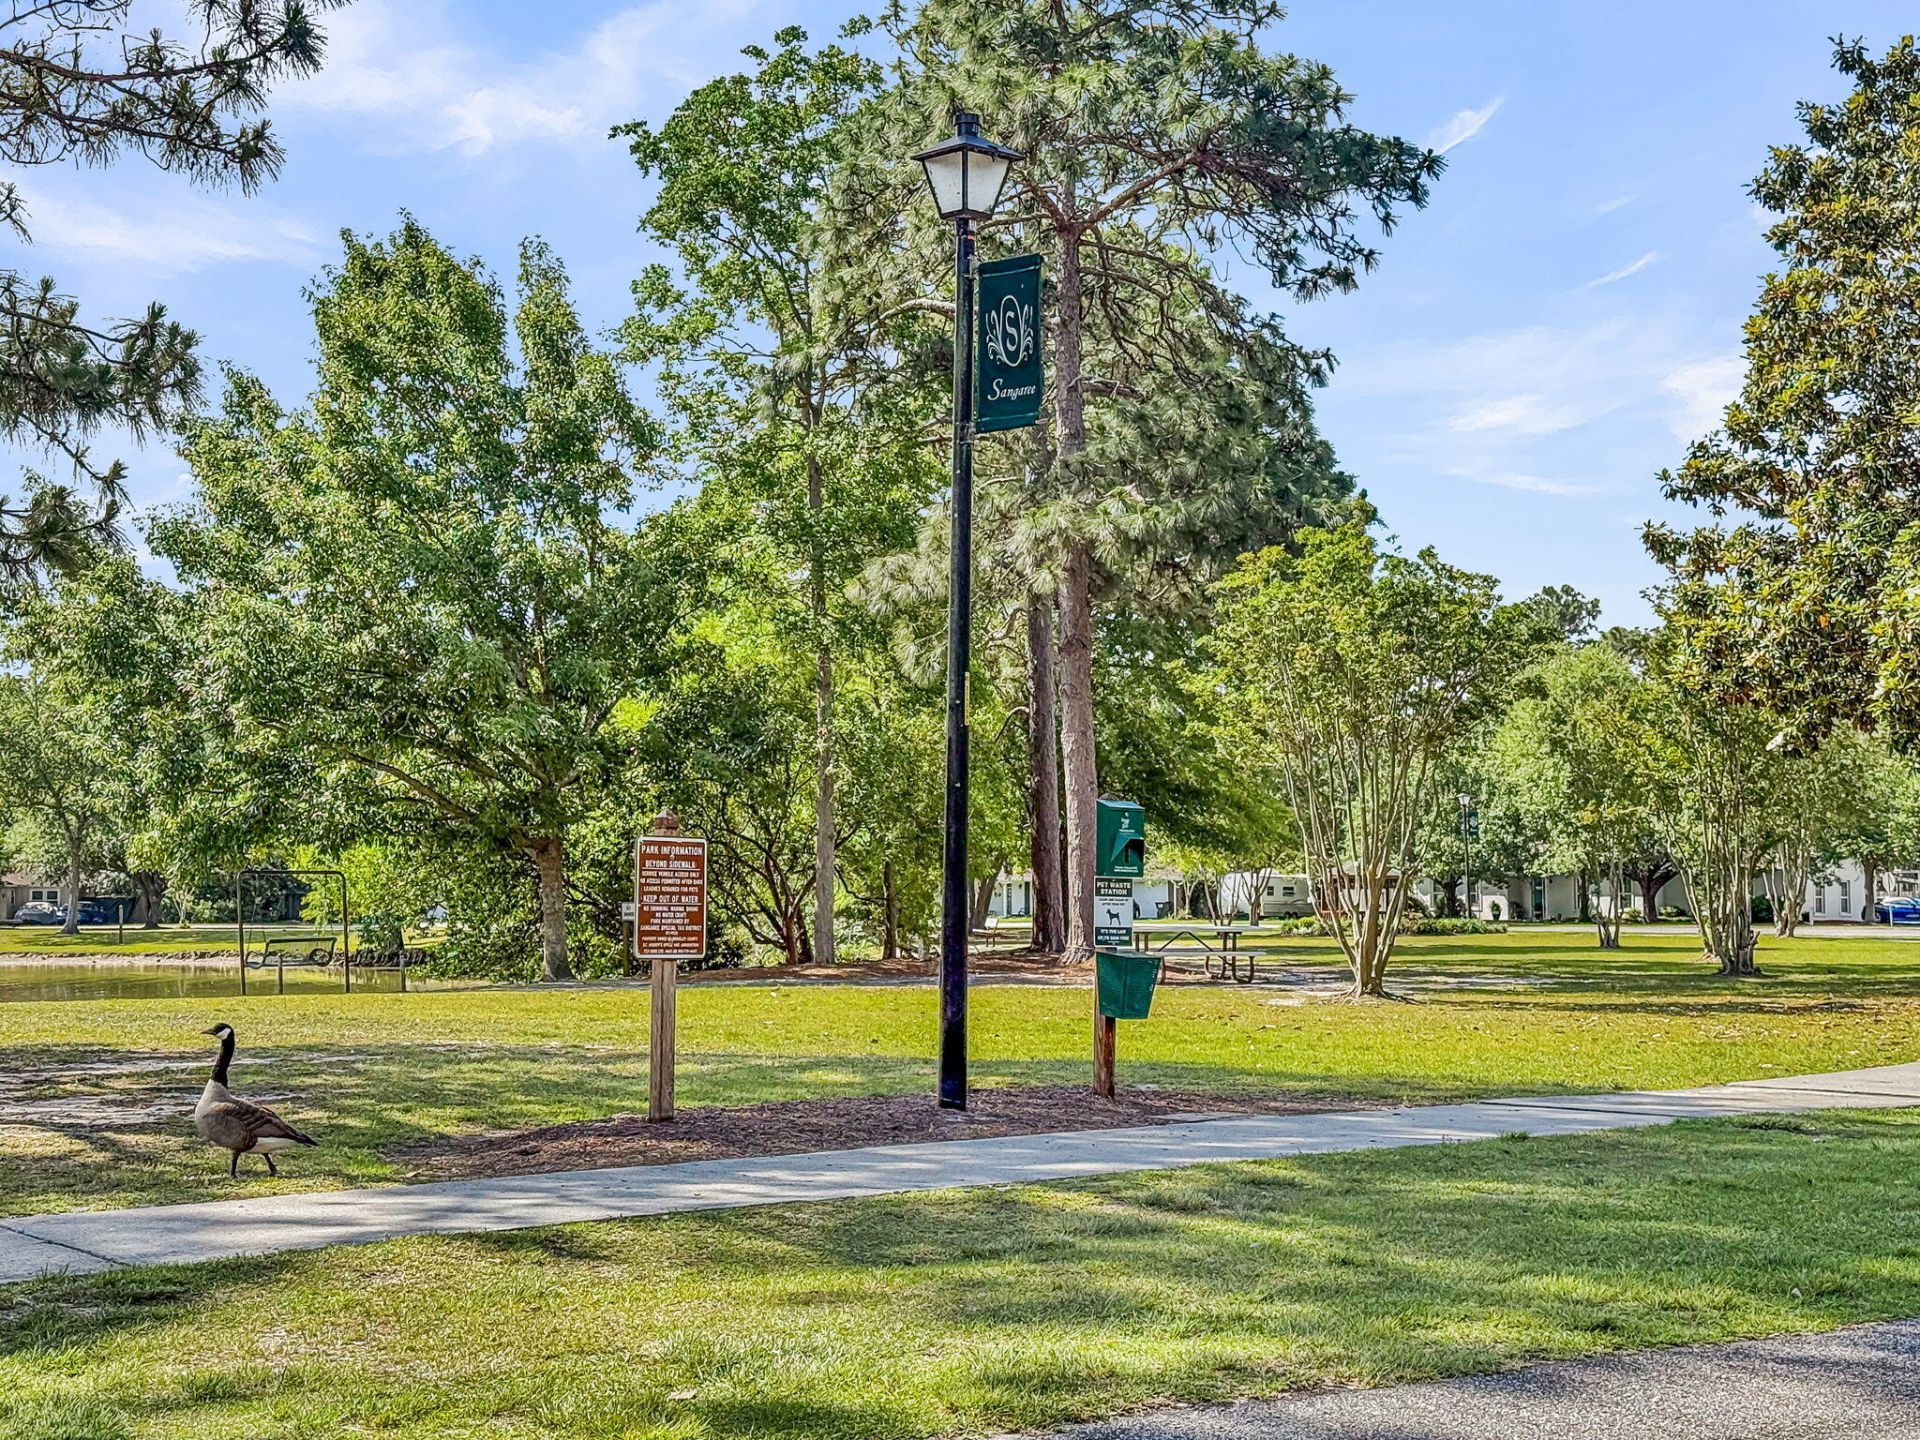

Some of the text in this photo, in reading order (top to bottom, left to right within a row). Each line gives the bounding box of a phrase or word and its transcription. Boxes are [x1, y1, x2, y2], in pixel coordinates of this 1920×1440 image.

[987, 378, 1036, 401] Sangaree
[641, 845, 703, 855] PARK INFORMATION
[645, 860, 668, 868] BEYOND
[643, 894, 658, 902] KEEP
